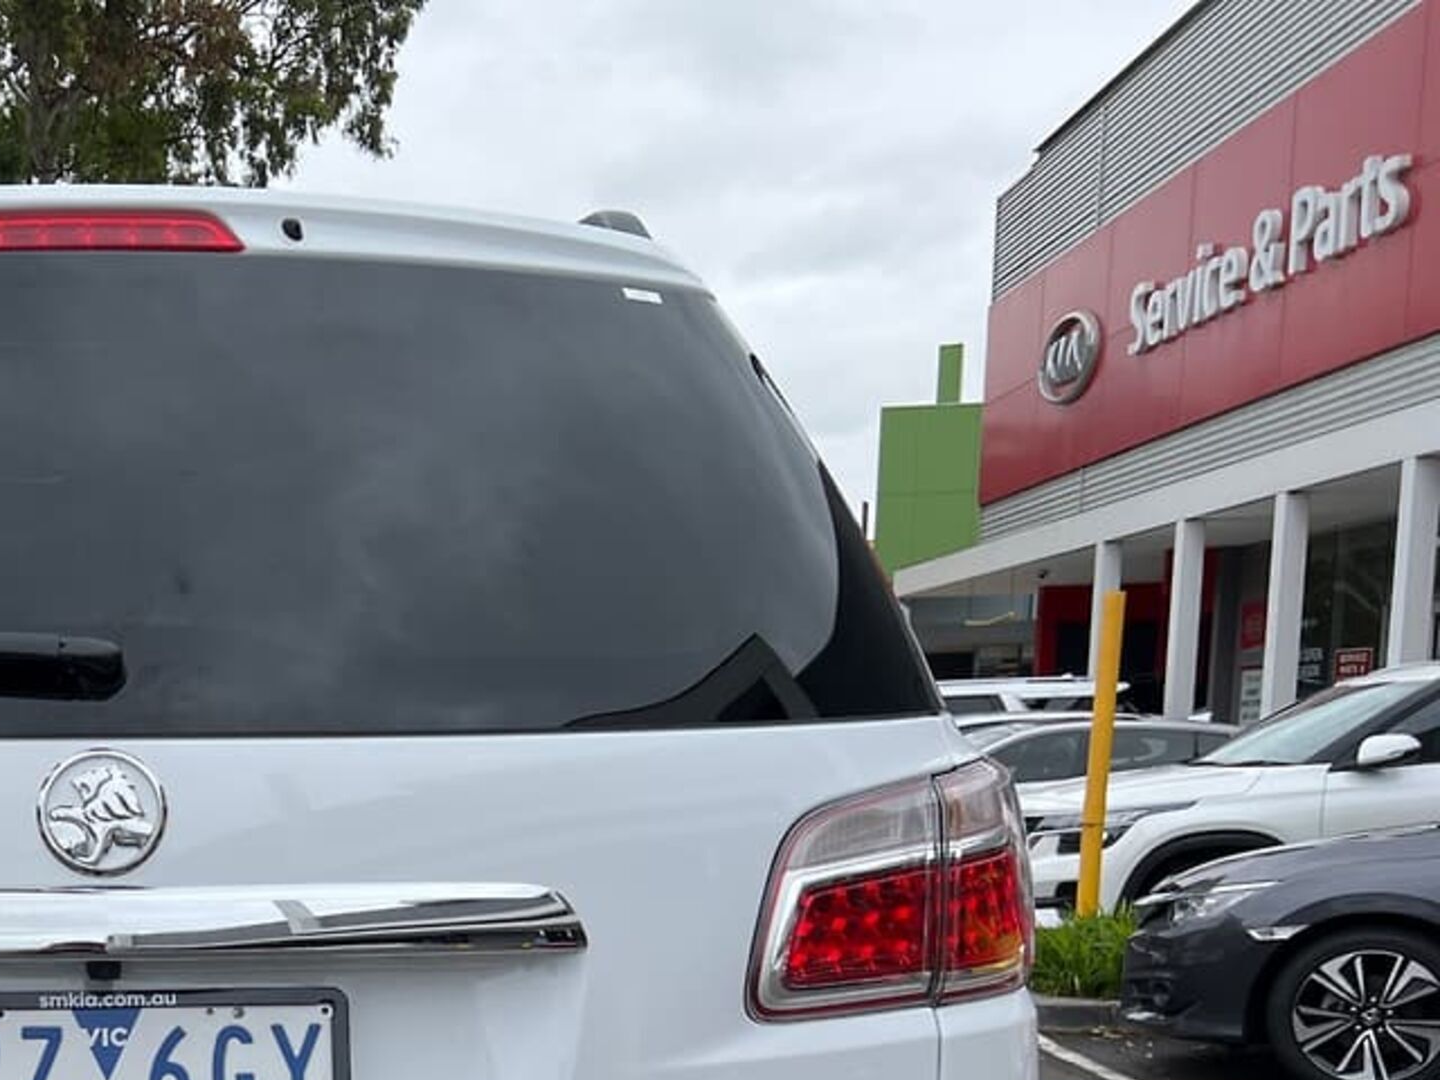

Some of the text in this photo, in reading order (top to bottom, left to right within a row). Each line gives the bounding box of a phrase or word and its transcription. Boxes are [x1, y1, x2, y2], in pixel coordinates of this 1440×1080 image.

[1127, 154, 1414, 357] Service & Parts
[39, 991, 177, 1008] smkia.com.au
[83, 1027, 129, 1047] VIC
